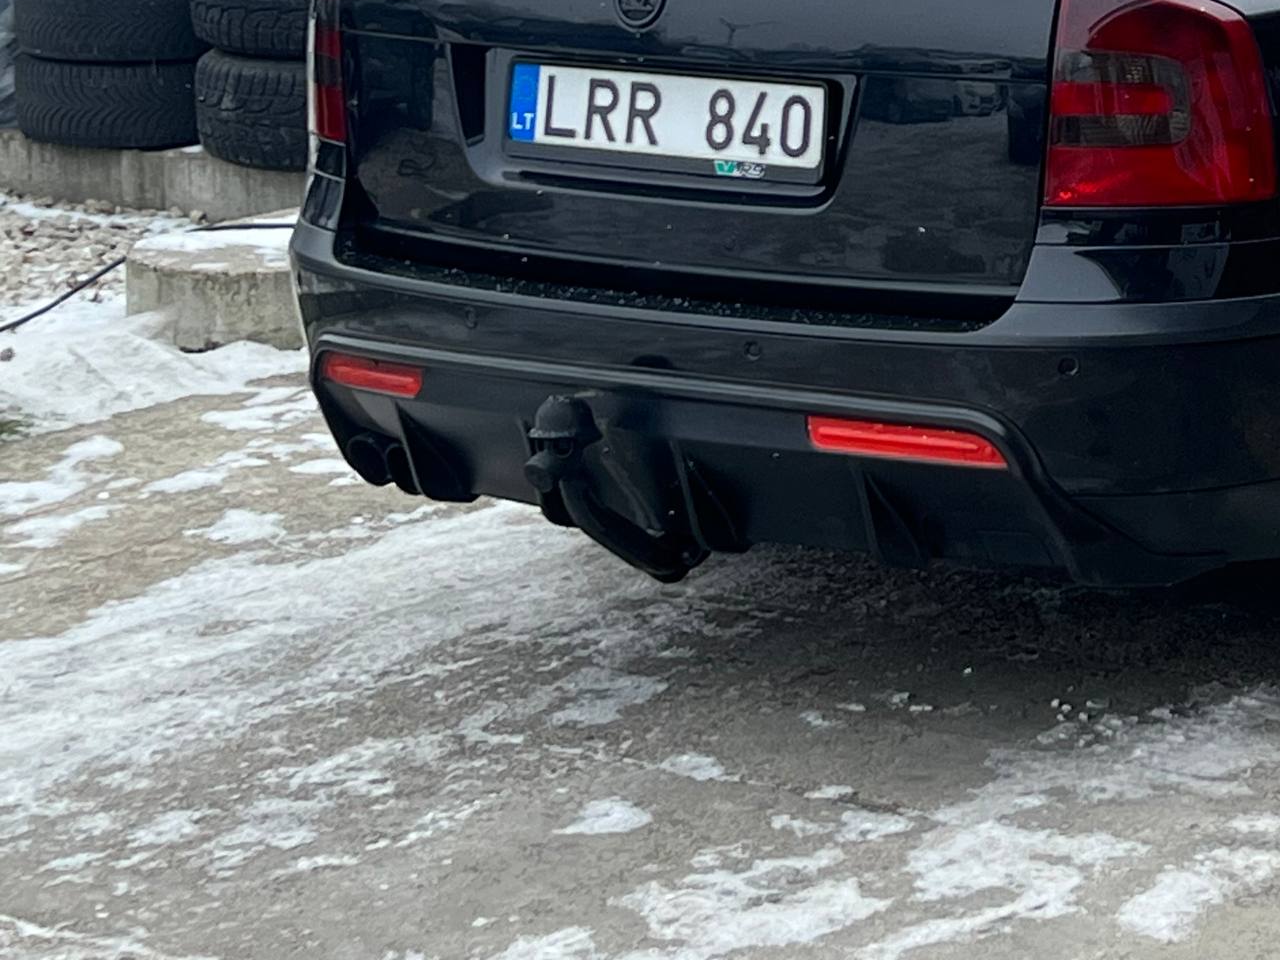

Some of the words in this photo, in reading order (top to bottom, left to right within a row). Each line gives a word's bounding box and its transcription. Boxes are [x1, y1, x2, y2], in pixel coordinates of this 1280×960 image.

[511, 111, 535, 130] LT
[544, 75, 659, 146] LRR
[706, 89, 812, 158] 840
